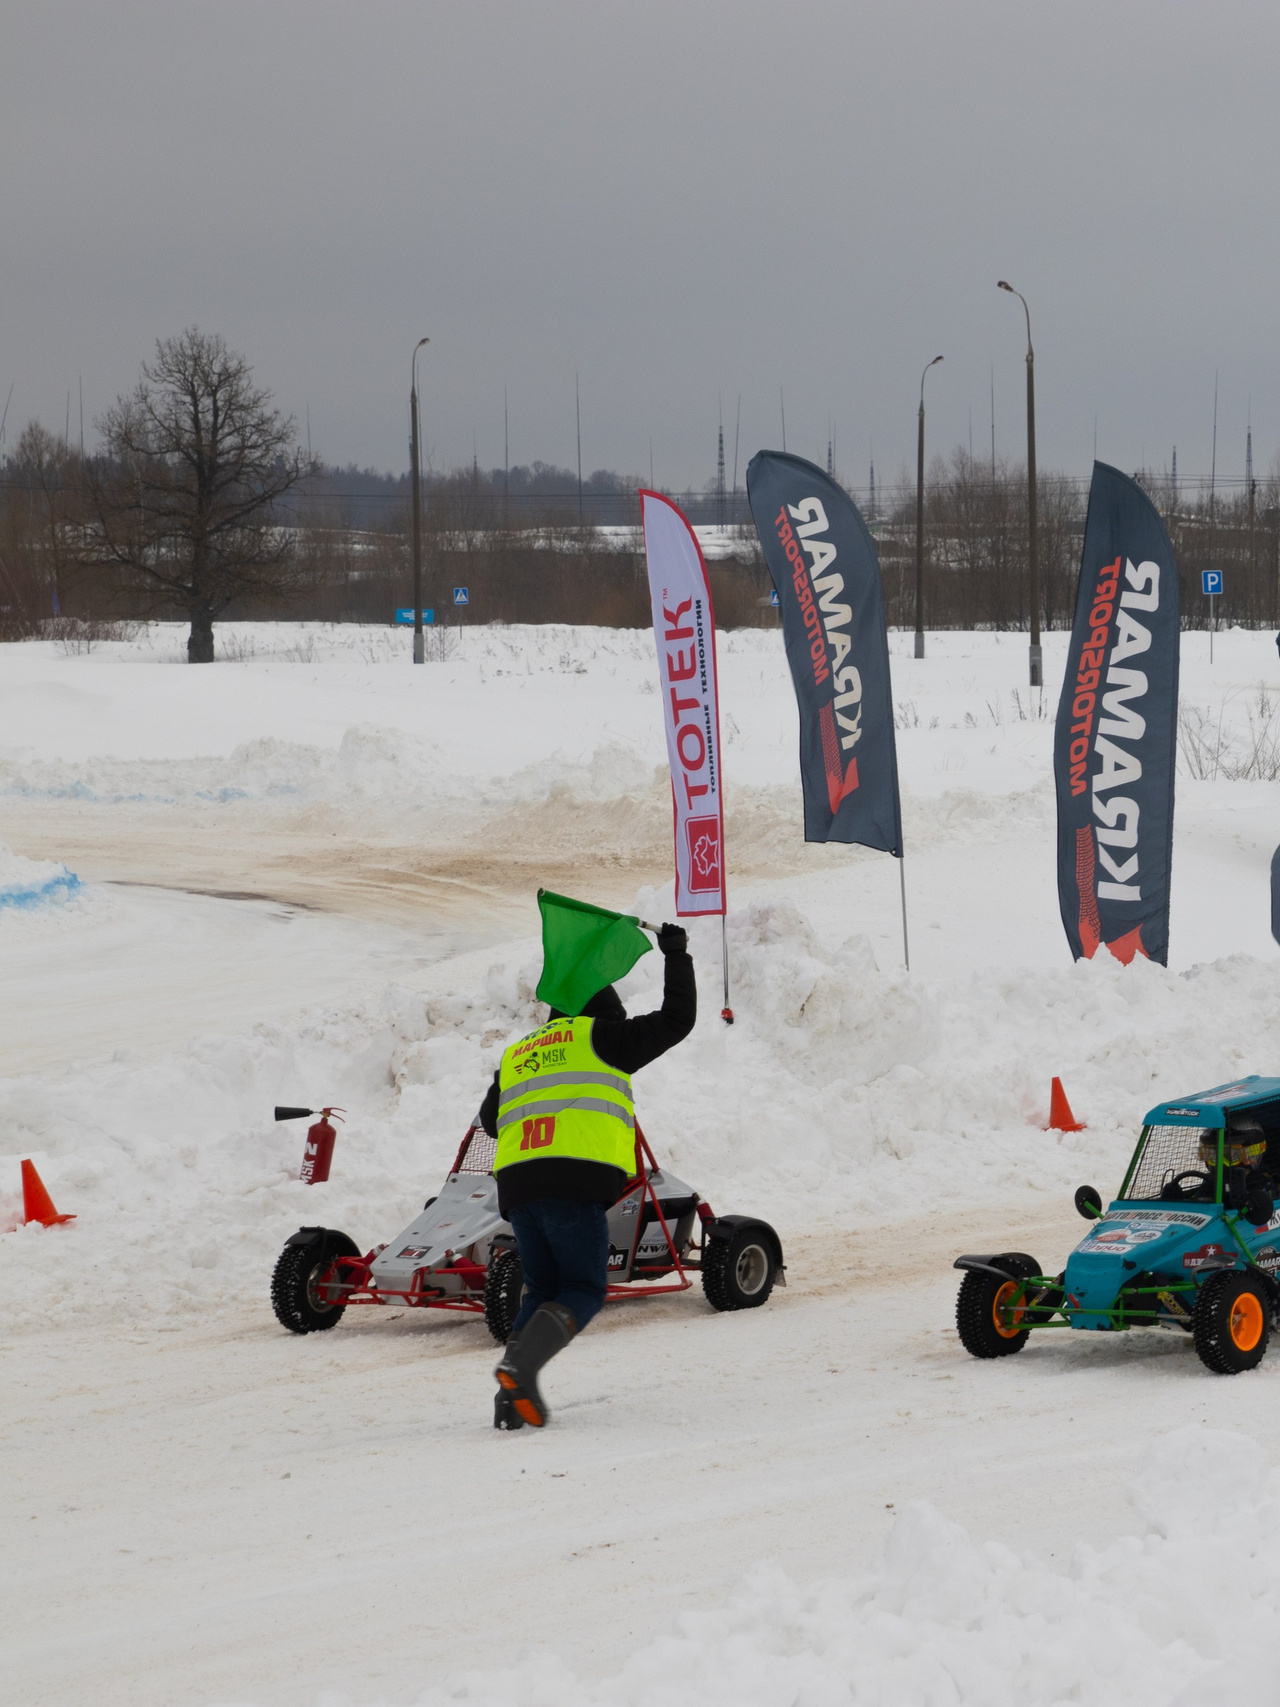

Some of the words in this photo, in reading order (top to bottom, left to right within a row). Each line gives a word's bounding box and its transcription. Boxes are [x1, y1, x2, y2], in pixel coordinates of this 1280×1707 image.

[1207, 573, 1219, 591] P
[695, 599, 708, 694] ТЕХНОЛОГИИ
[703, 704, 717, 794] ТОПЛИВНЫЕ
[511, 1029, 574, 1060] МАРШАЛ
[542, 1047, 567, 1065] MSK
[519, 1115, 556, 1151] 10
[1104, 1211, 1163, 1221] АВТОКРОСС
[1160, 1212, 1208, 1227] РОССИИ
